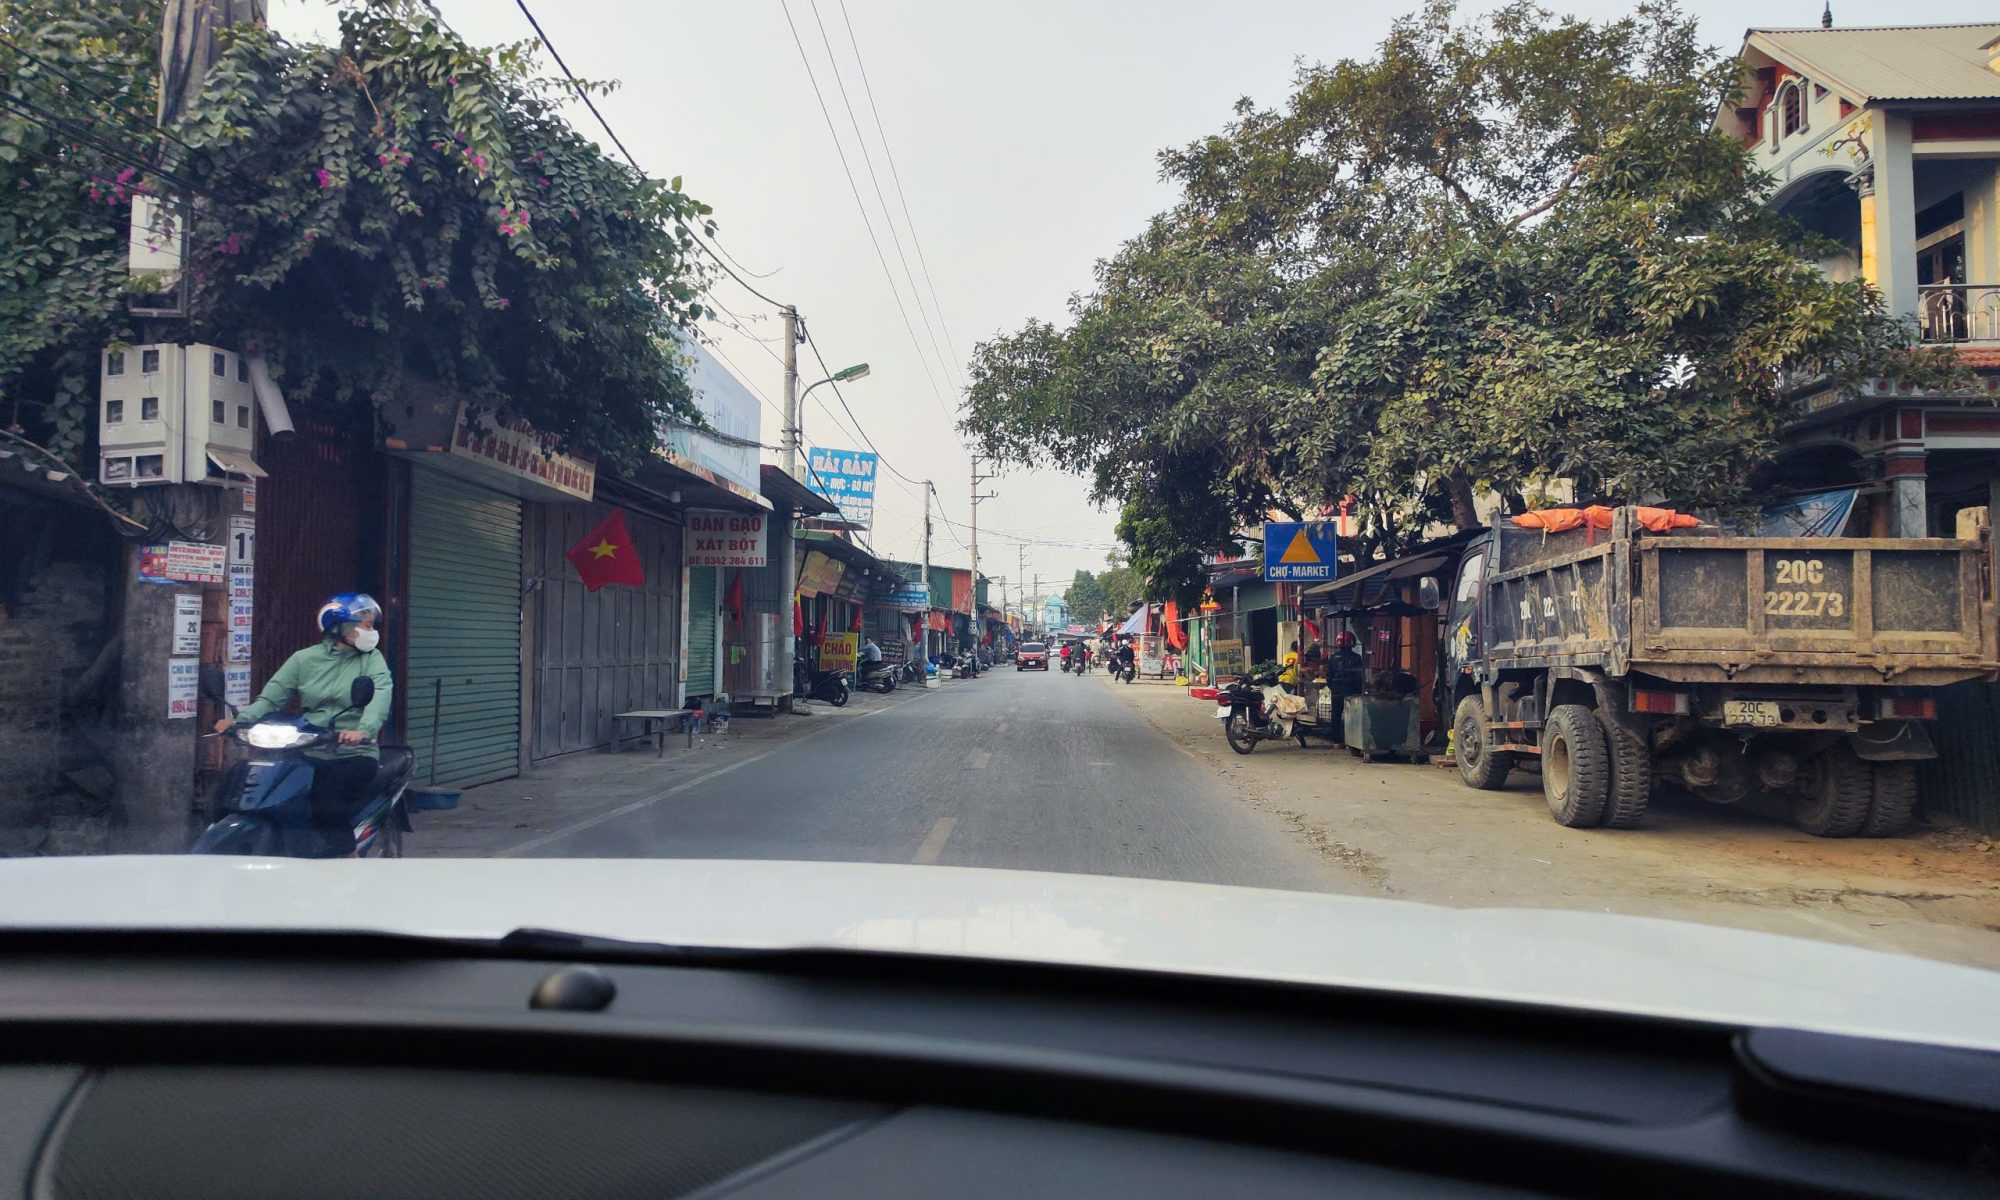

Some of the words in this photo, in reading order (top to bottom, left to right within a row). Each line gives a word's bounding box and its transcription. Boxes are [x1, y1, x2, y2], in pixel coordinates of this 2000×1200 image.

[813, 450, 840, 473] HẢI
[842, 453, 873, 476] SẢN
[692, 514, 724, 531] BÁN
[730, 517, 761, 535] GẠO
[728, 537, 758, 553] BỘT
[748, 556, 764, 565] 611
[1776, 559, 1824, 584] 20C
[824, 640, 852, 656] CHÁO
[1740, 702, 1766, 714] 20C
